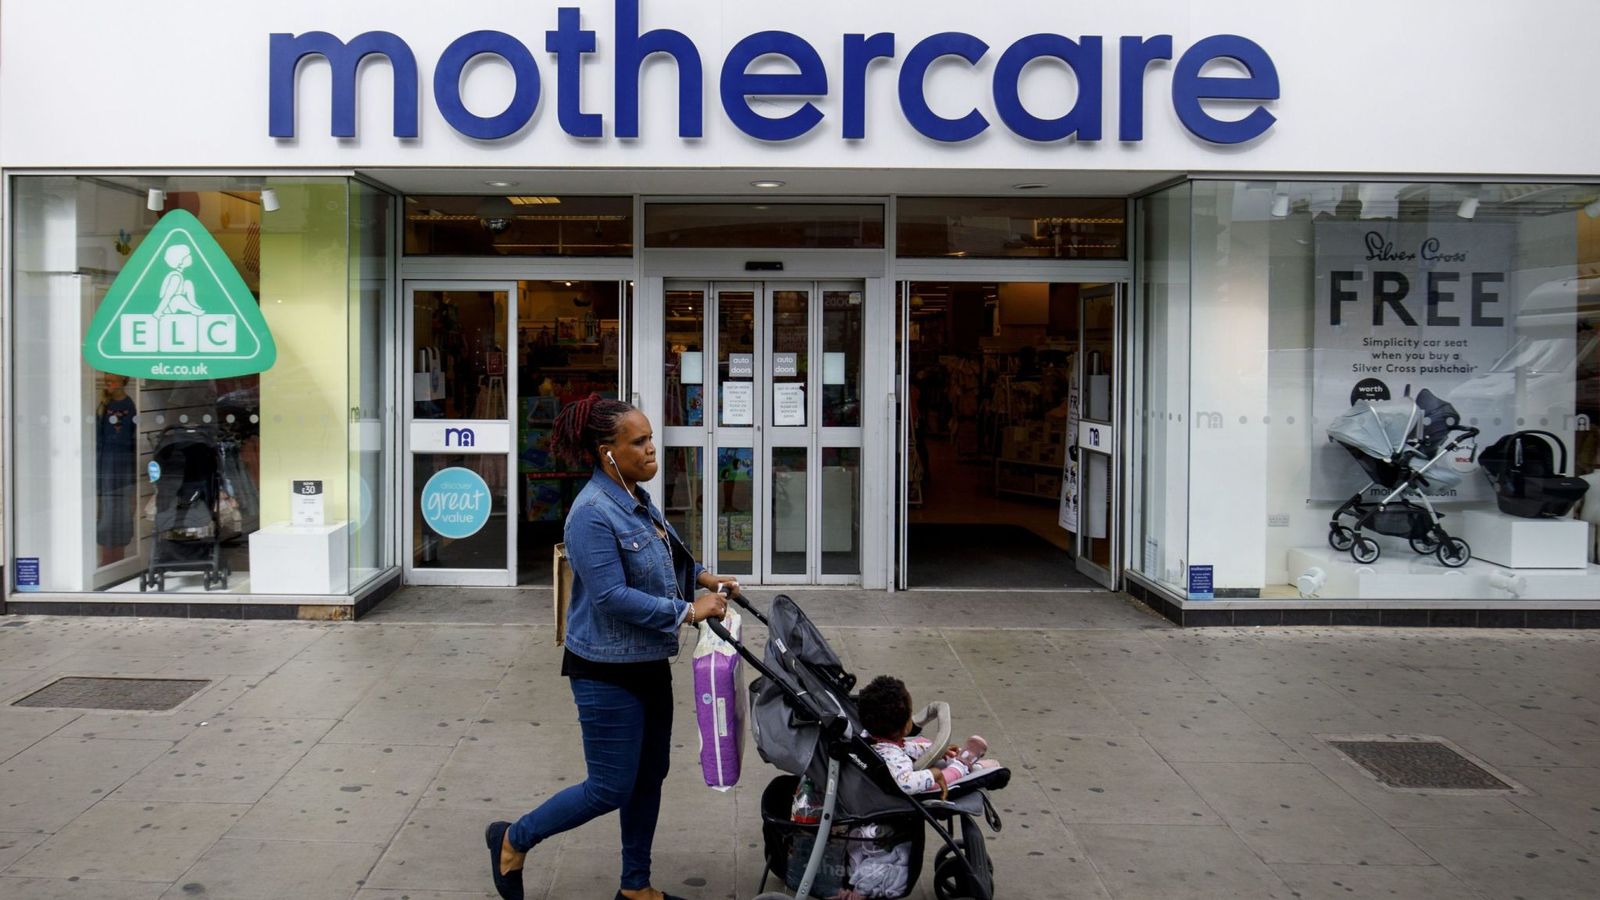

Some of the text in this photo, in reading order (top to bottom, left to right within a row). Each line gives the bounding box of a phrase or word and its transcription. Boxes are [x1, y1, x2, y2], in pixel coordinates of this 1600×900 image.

[269, 0, 1279, 142] mothercare
[1365, 231, 1466, 262] Silver Cross
[1330, 271, 1504, 326] FREE
[1363, 337, 1419, 349] Simplicity
[1444, 339, 1468, 347] seat
[1372, 351, 1402, 360] when
[1405, 353, 1425, 362] you
[1429, 351, 1450, 362] buy
[151, 362, 208, 375] elc.co.uk
[730, 366, 751, 374] doors
[1352, 363, 1382, 373] Silver
[1386, 364, 1416, 373] Cross
[428, 490, 484, 520] great
[441, 511, 474, 523] value
